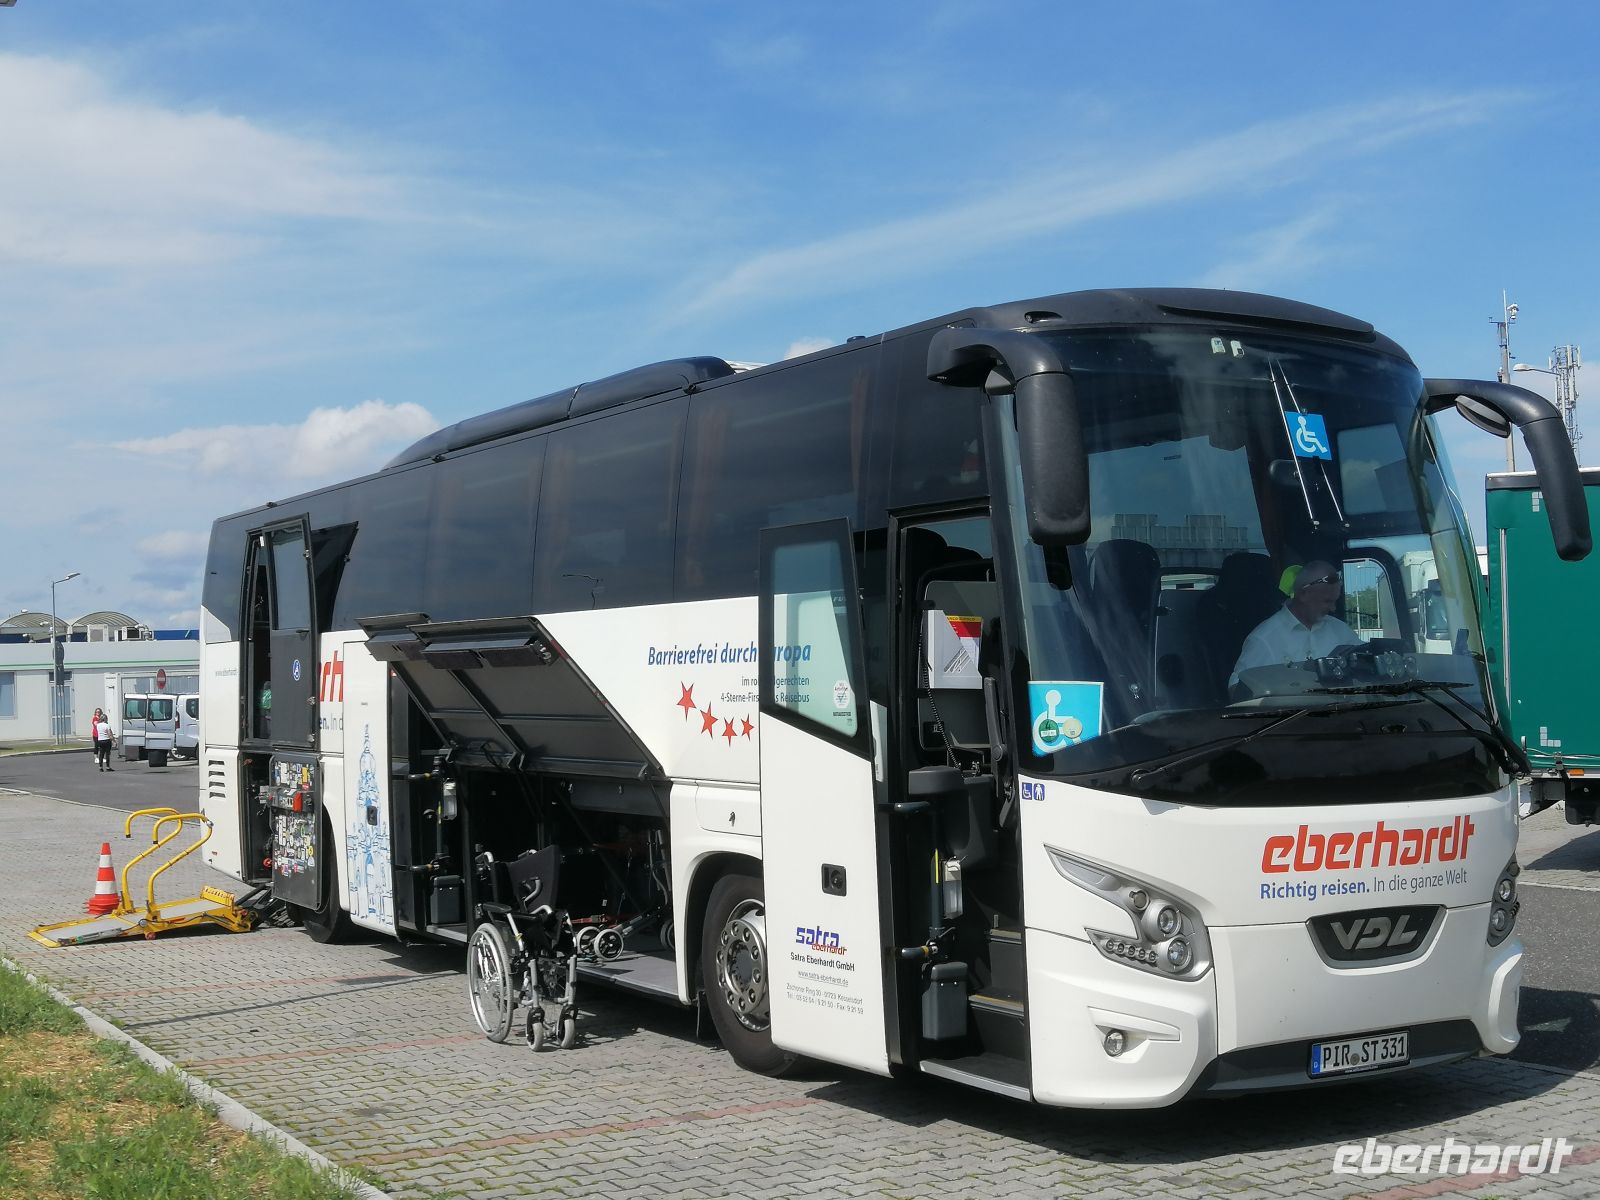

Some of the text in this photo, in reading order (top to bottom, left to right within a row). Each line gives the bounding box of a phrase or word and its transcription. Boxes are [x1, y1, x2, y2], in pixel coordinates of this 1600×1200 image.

[648, 643, 718, 665] Barrierefrei
[720, 641, 758, 663] durch
[742, 676, 750, 686] im
[780, 691, 810, 703] Reisebus
[1261, 814, 1475, 874] eberhardt
[1260, 867, 1467, 901] Richtig reisen. In die ganze Welt
[796, 926, 840, 947] satra
[1330, 915, 1418, 950] VDL
[811, 944, 847, 955] eberhardt
[790, 952, 855, 971] Satra Eberhardt GmbH
[1323, 1044, 1350, 1068] PIR
